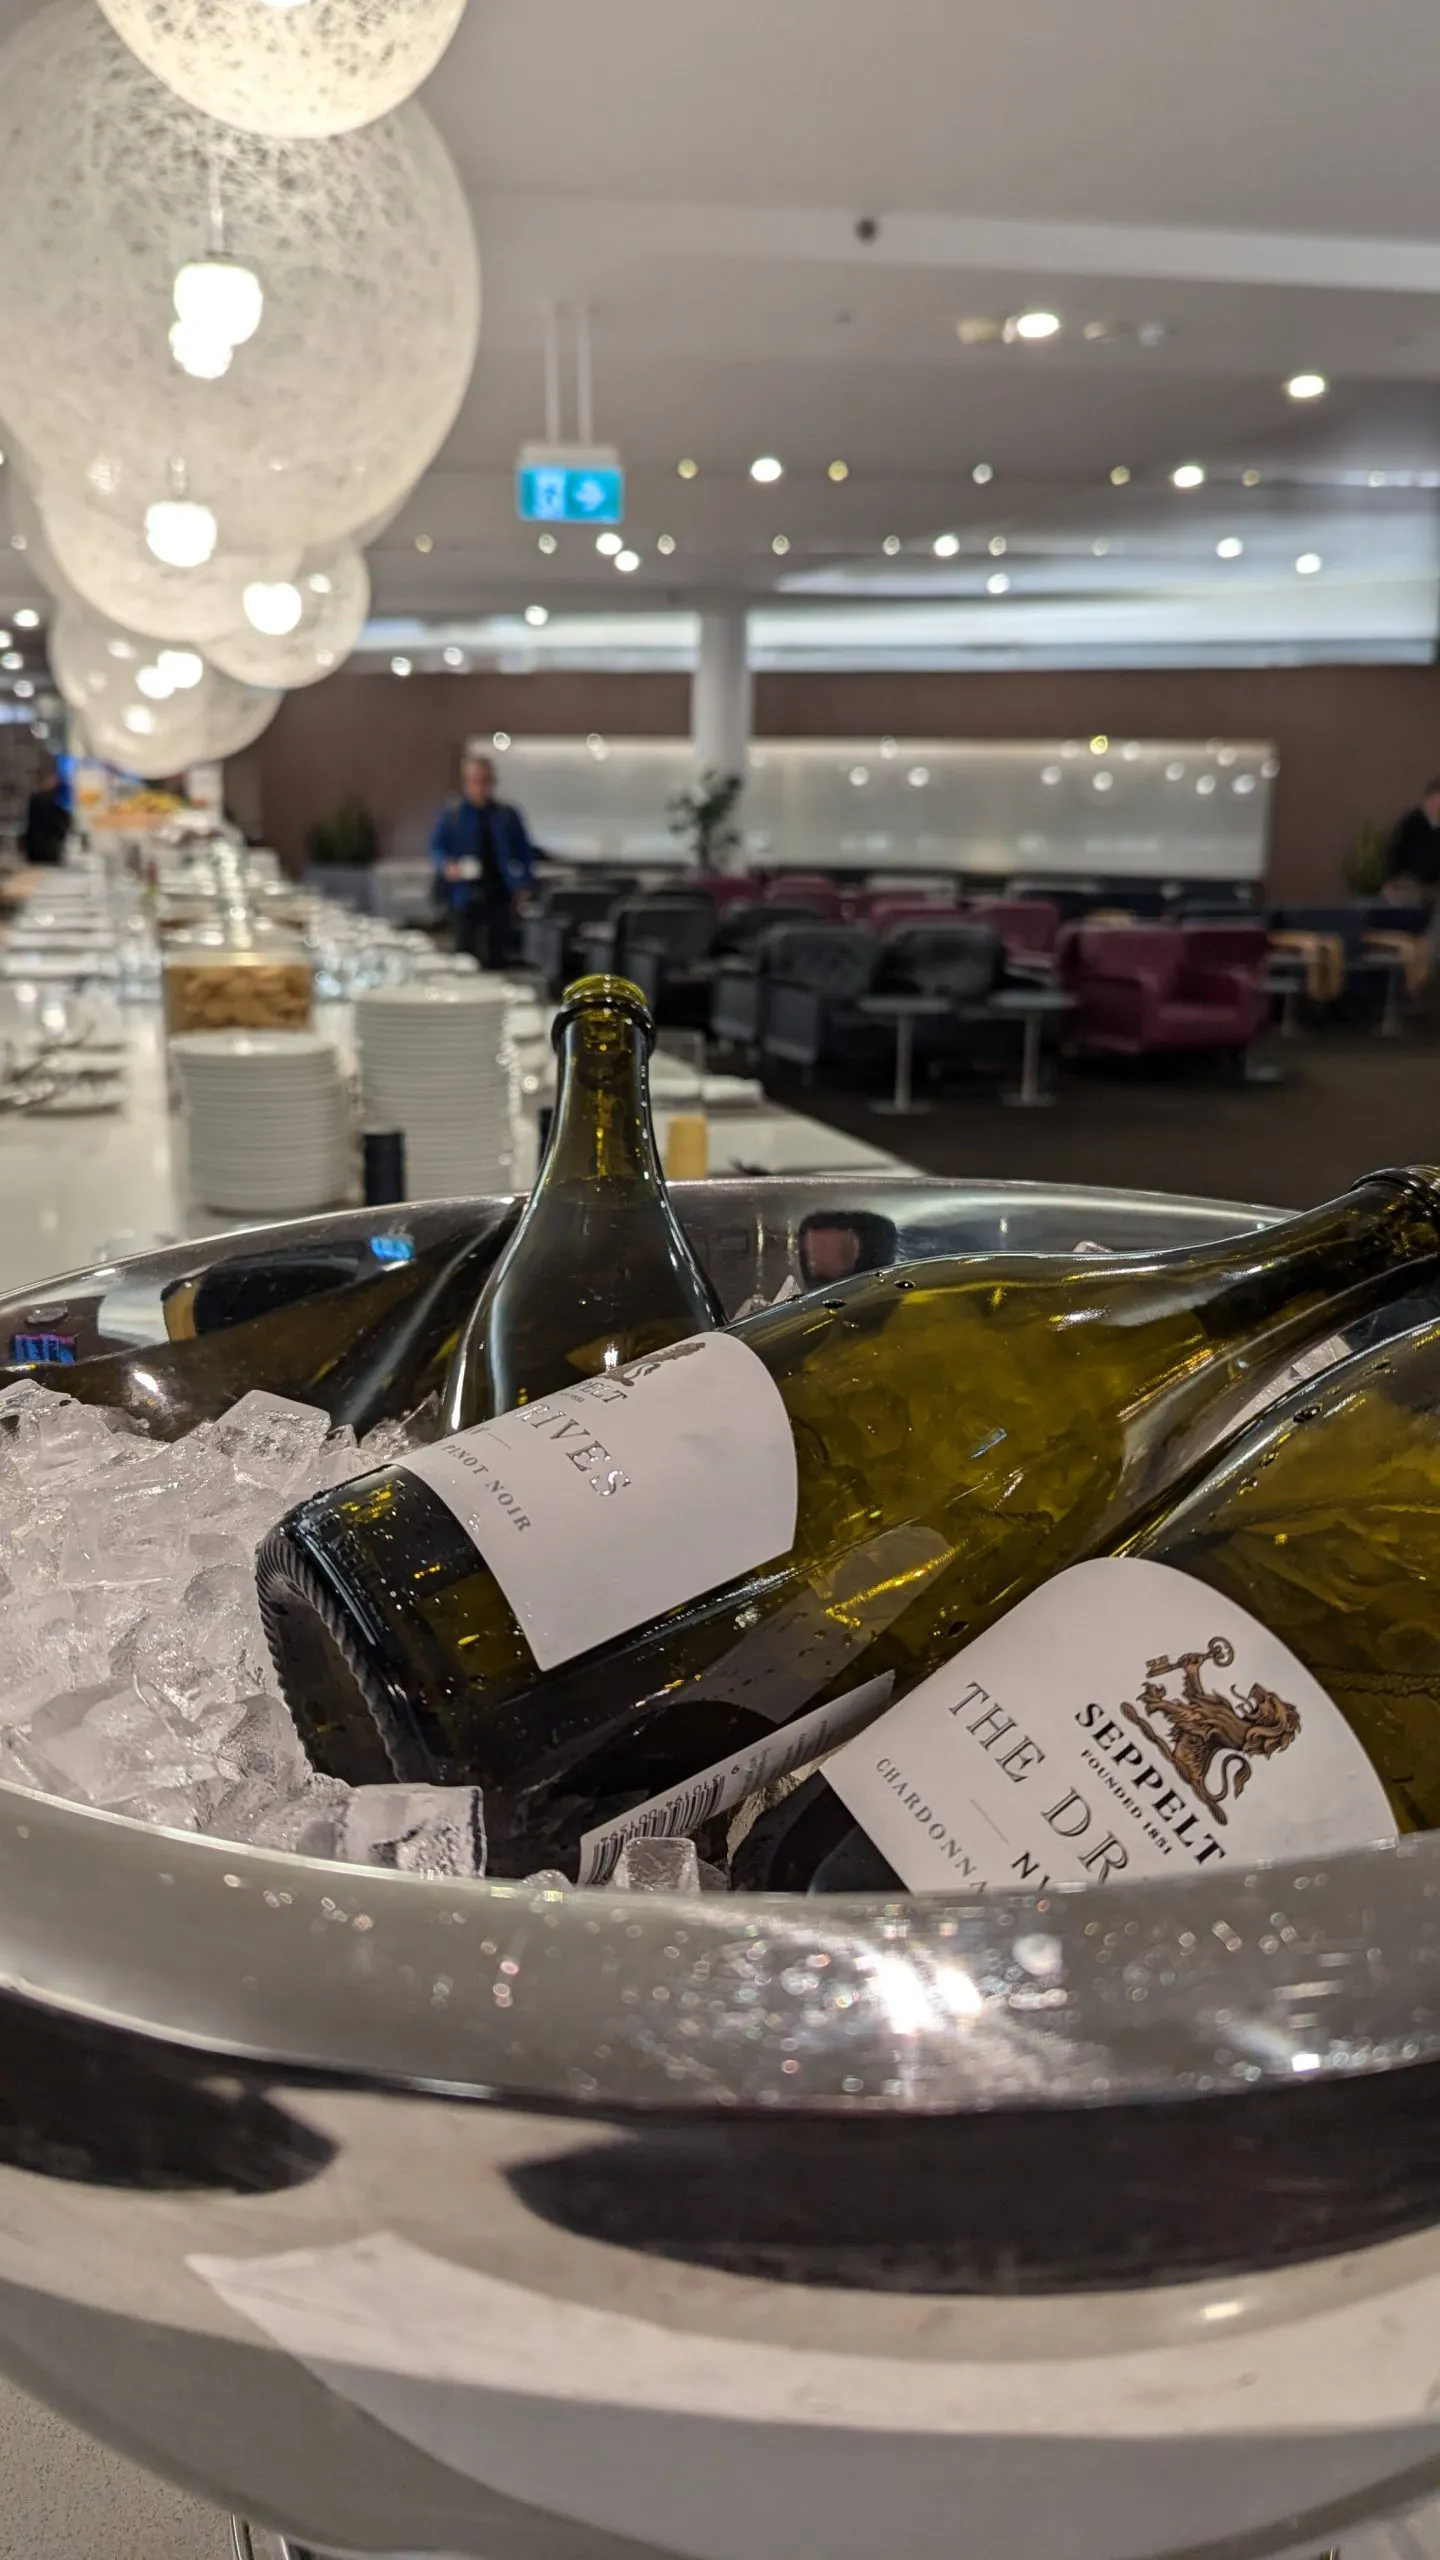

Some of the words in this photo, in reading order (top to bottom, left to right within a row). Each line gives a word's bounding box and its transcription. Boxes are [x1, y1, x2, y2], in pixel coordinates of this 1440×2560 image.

[442, 1443, 490, 1475] PINOT
[485, 1479, 532, 1532] NOIR
[948, 1681, 1046, 1783] THE
[1074, 1703, 1226, 1865] SEPPELT
[1080, 1750, 1143, 1819] FOUNDED
[1142, 1821, 1174, 1856] 1851
